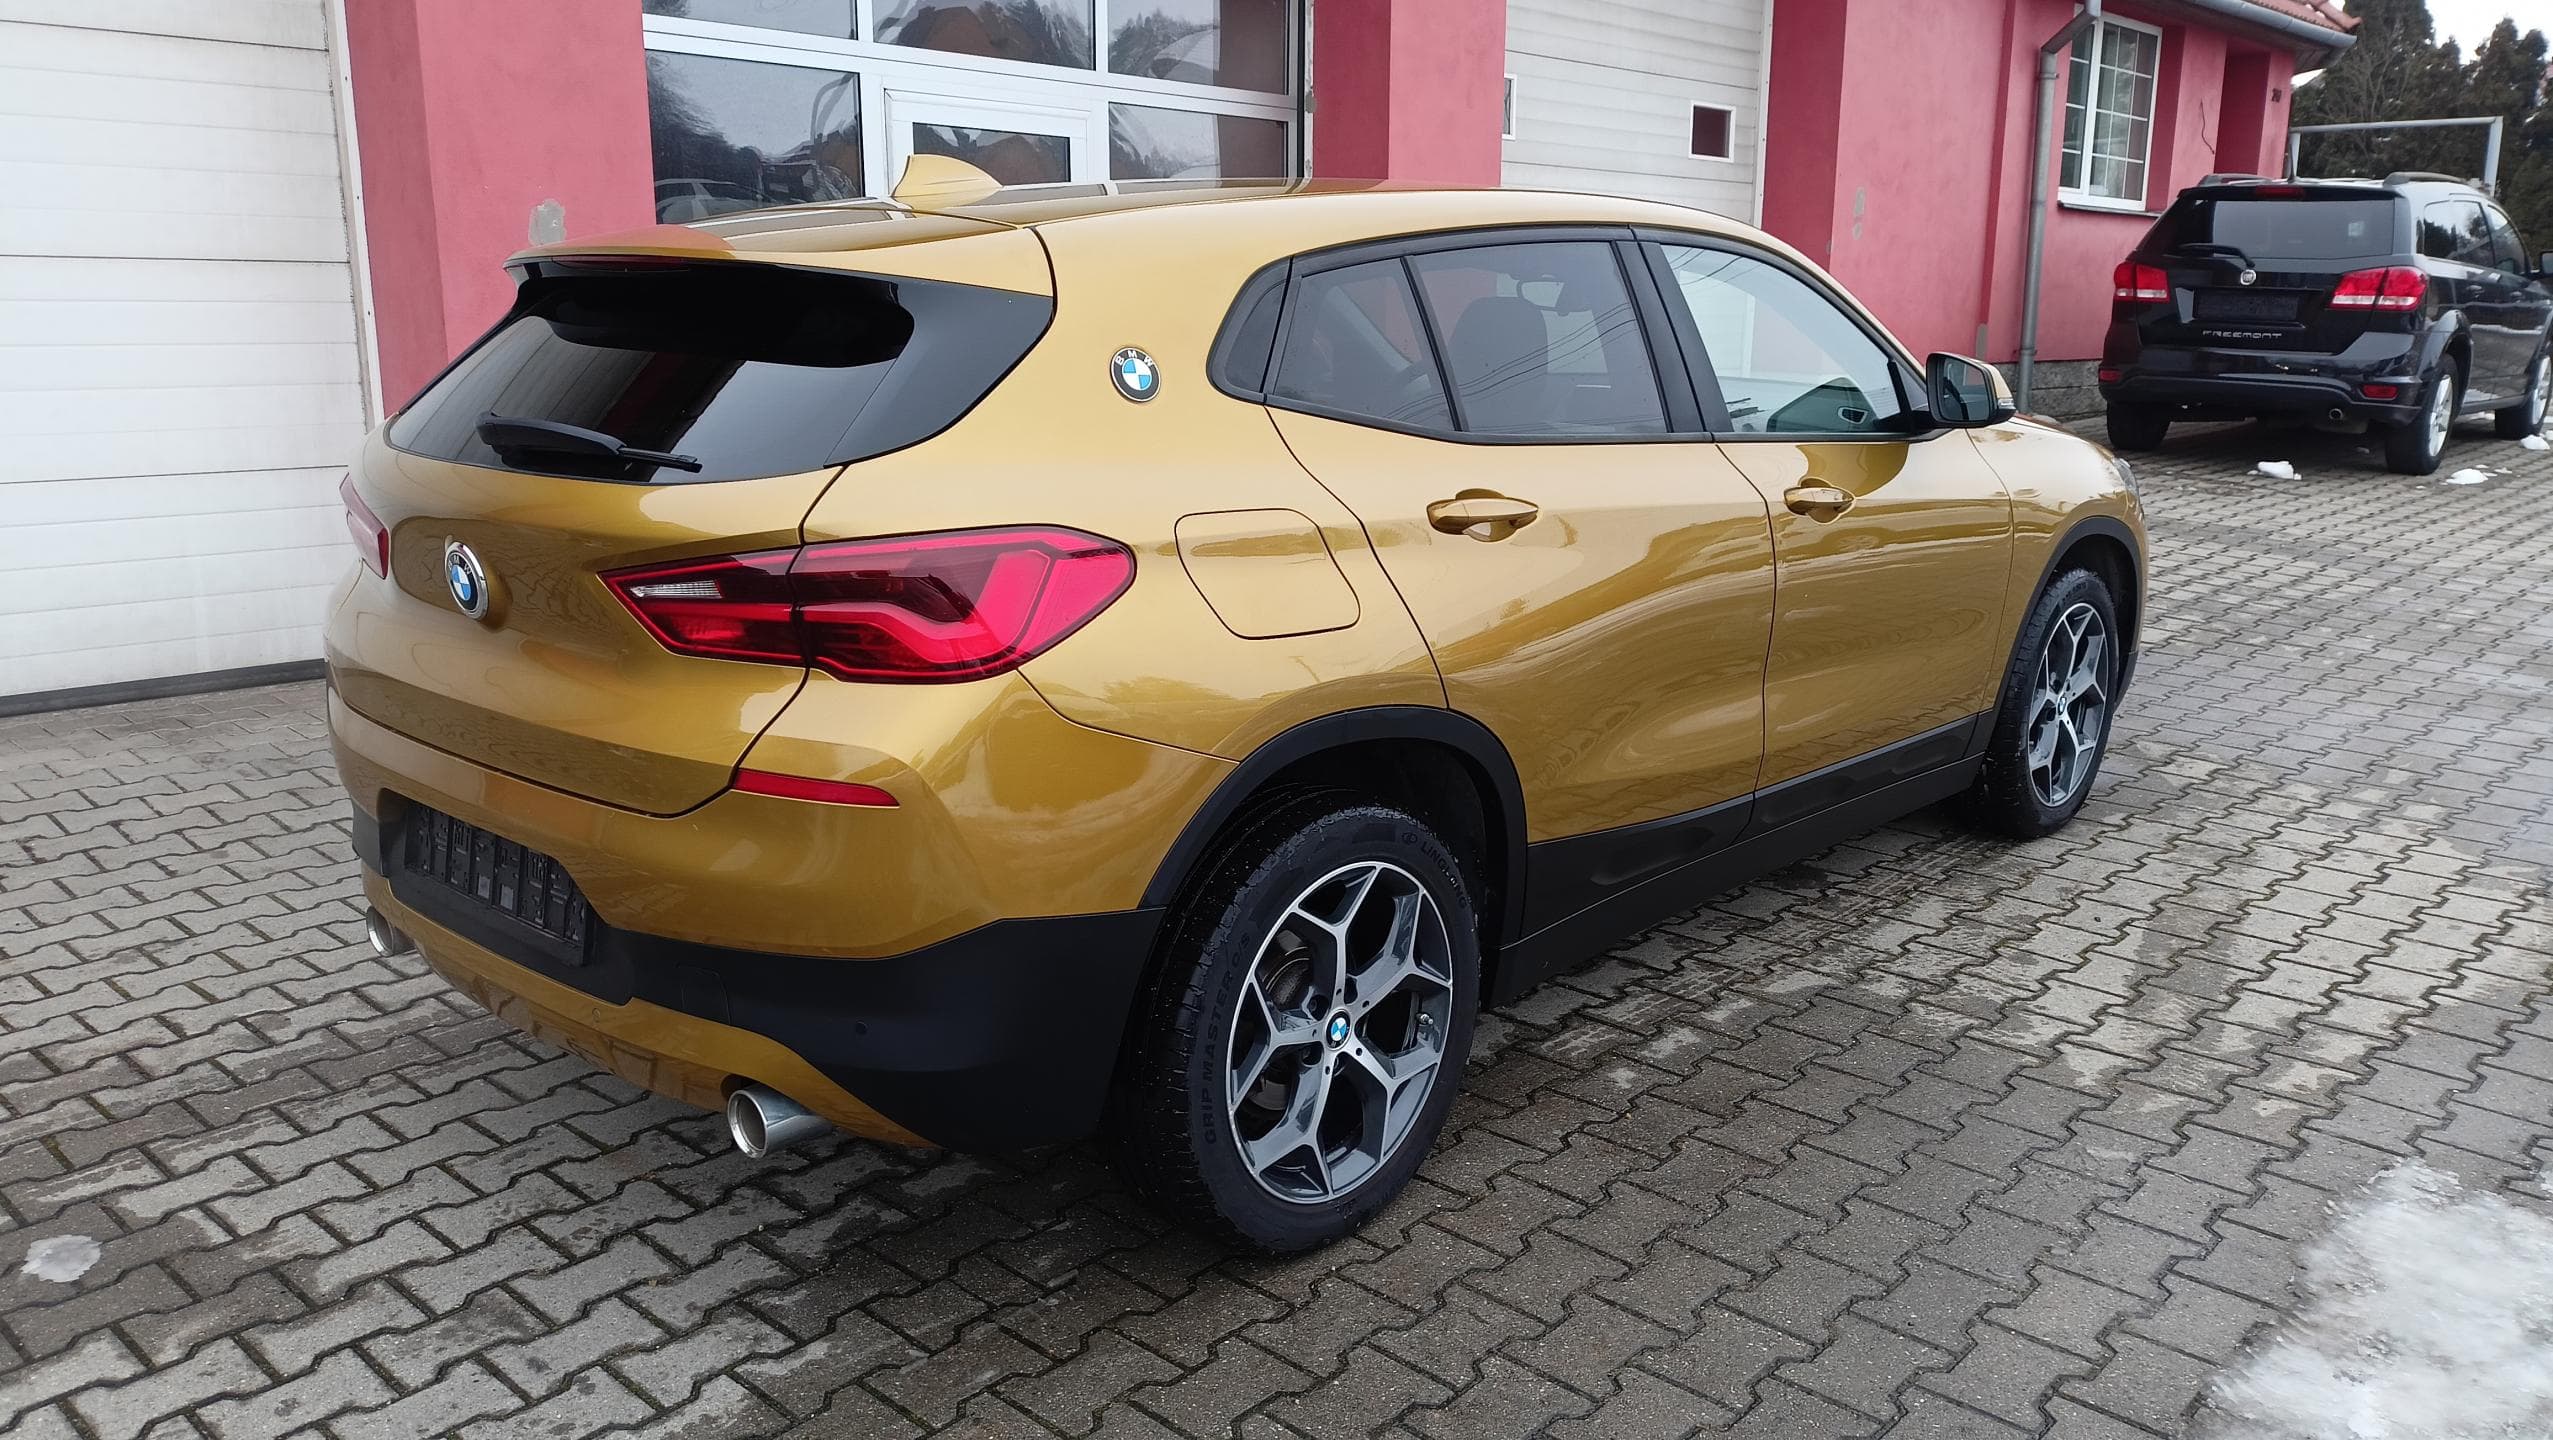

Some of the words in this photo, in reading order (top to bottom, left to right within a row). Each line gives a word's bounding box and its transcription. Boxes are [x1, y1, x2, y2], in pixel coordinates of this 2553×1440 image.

[2202, 329, 2282, 339] FREEMONT
[1115, 350, 1153, 366] BMW
[1202, 970, 1233, 1081] MASTER
[1199, 1087, 1217, 1144] GRIP
